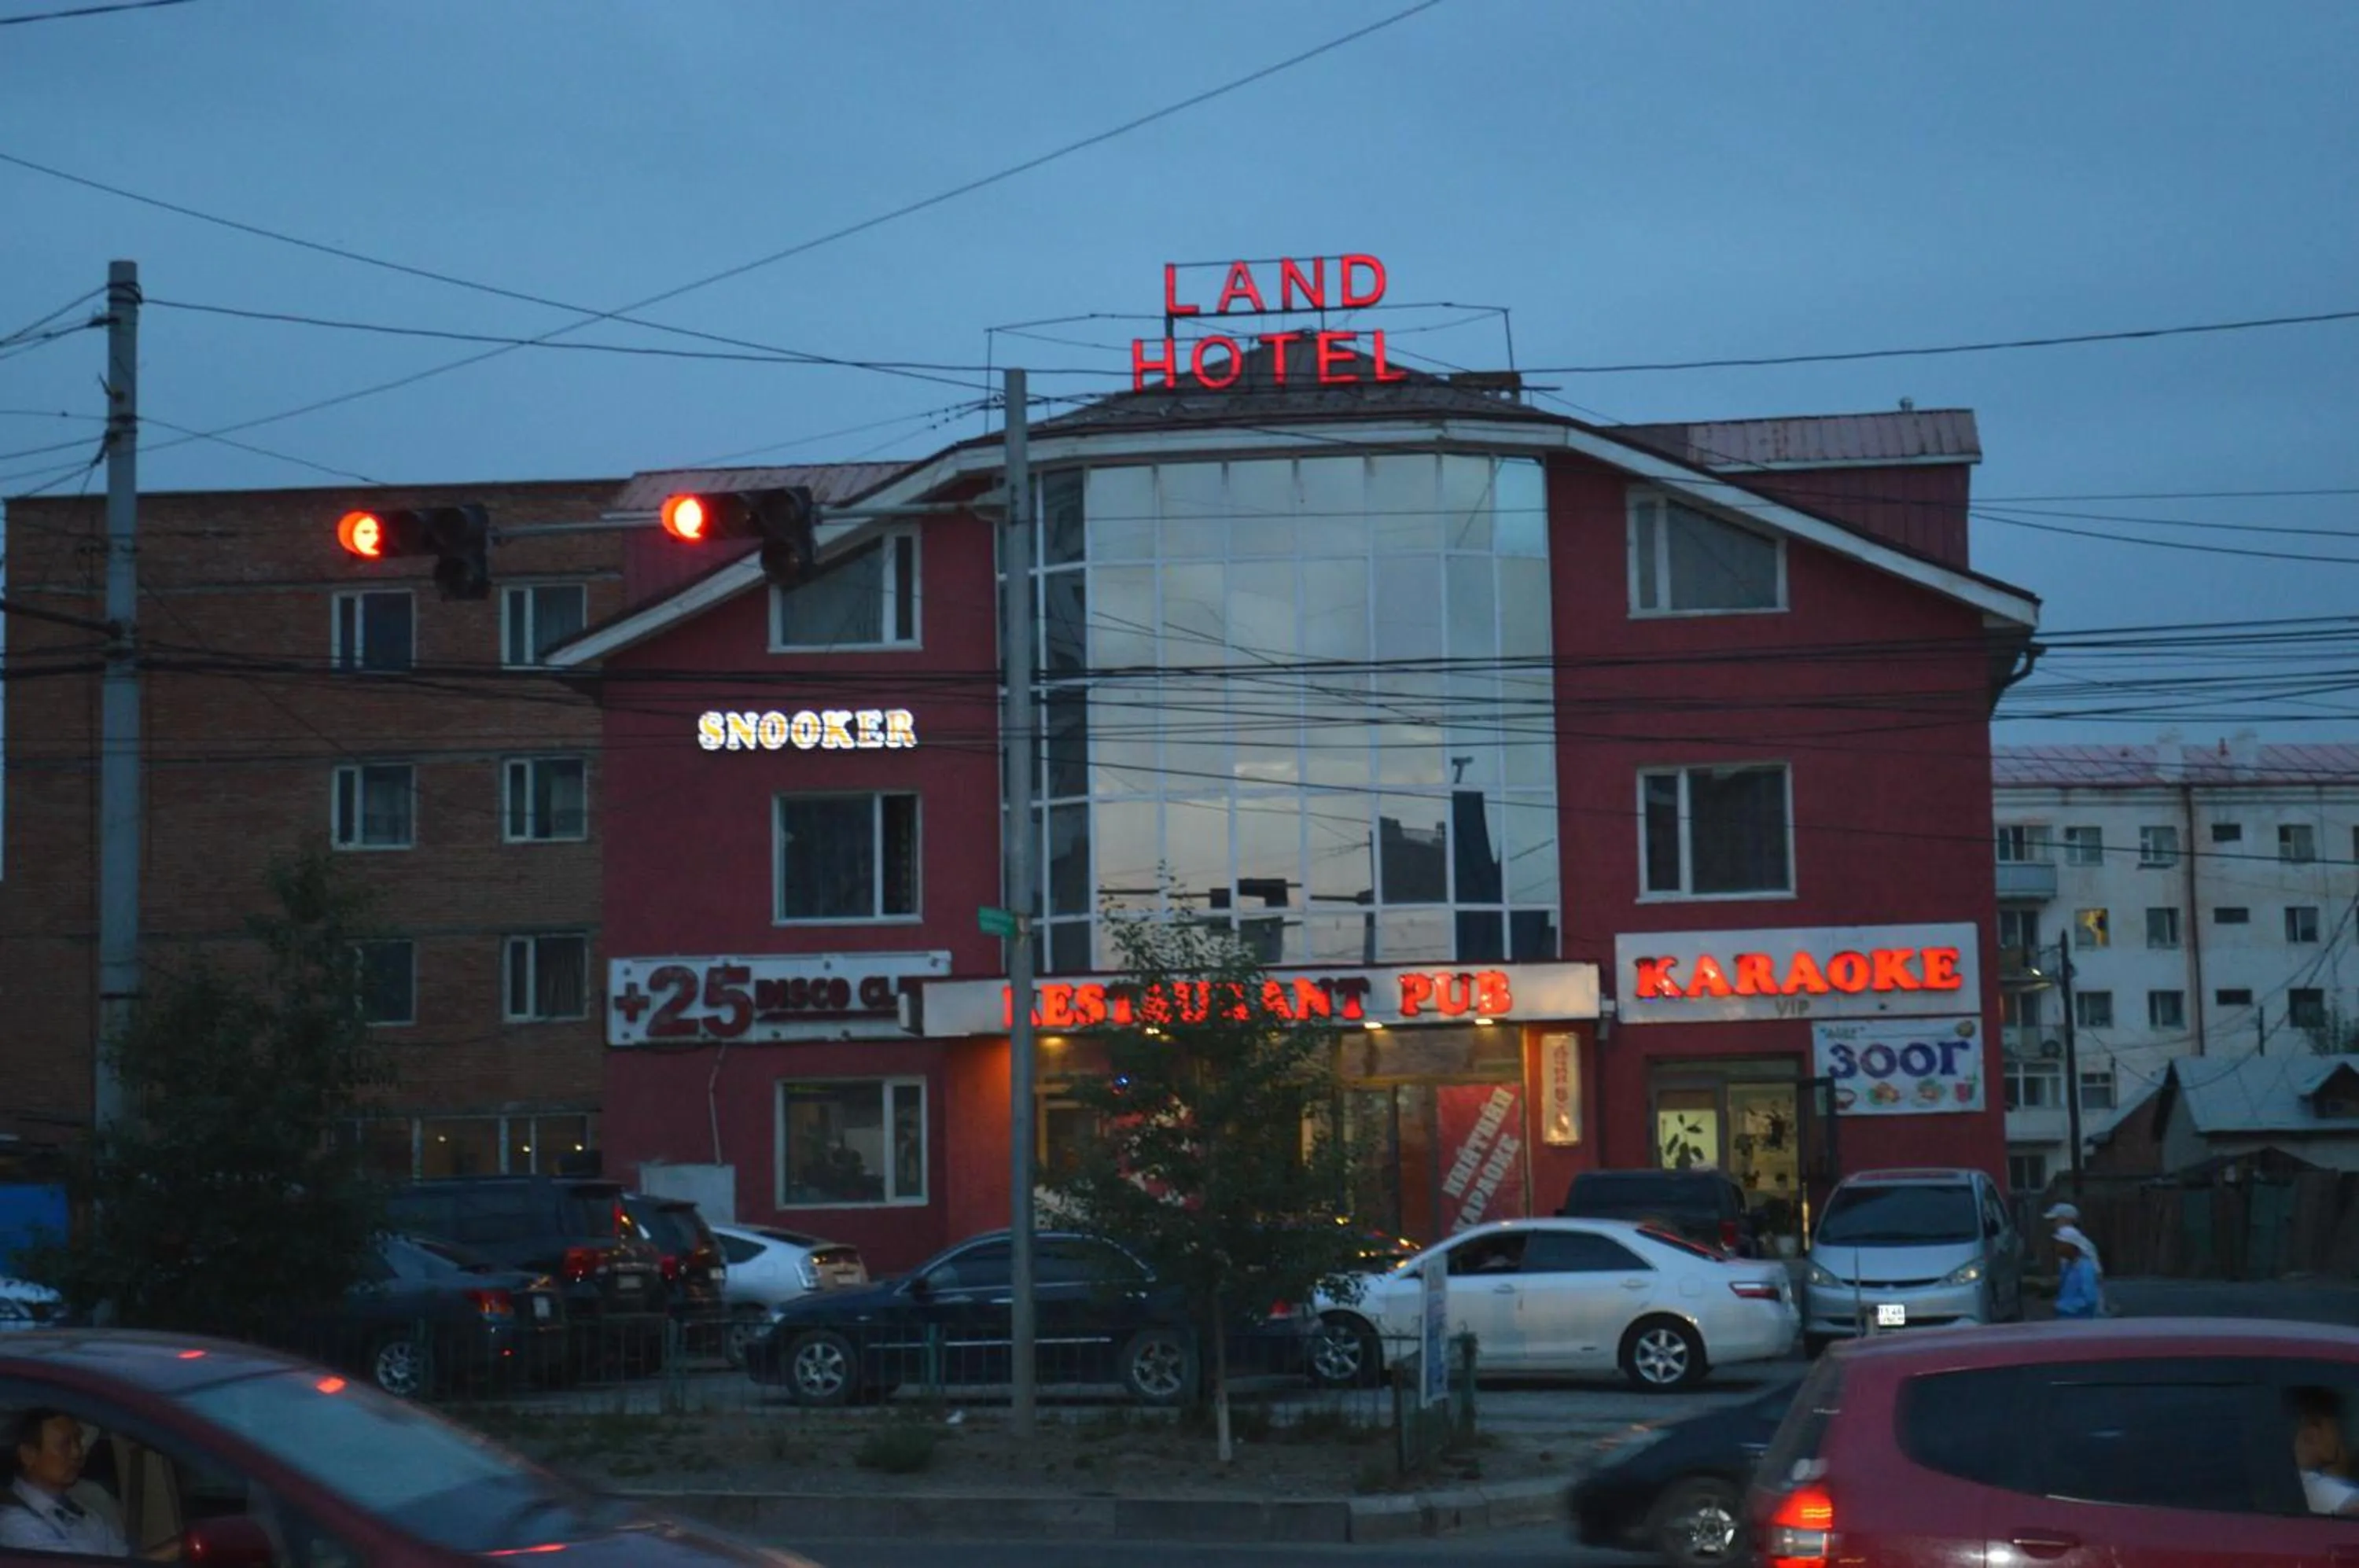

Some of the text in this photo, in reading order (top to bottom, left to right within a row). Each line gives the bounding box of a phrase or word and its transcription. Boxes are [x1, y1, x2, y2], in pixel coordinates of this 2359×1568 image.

[1165, 253, 1386, 315] LAND
[1132, 329, 1409, 393] HOTEL
[697, 709, 918, 750] SNOOKER
[755, 977, 852, 1010] DISCO
[859, 975, 899, 1009] CL
[1398, 970, 1513, 1018] PUB
[1635, 947, 1963, 998] KARAOKE
[1774, 998, 1811, 1016] VIP
